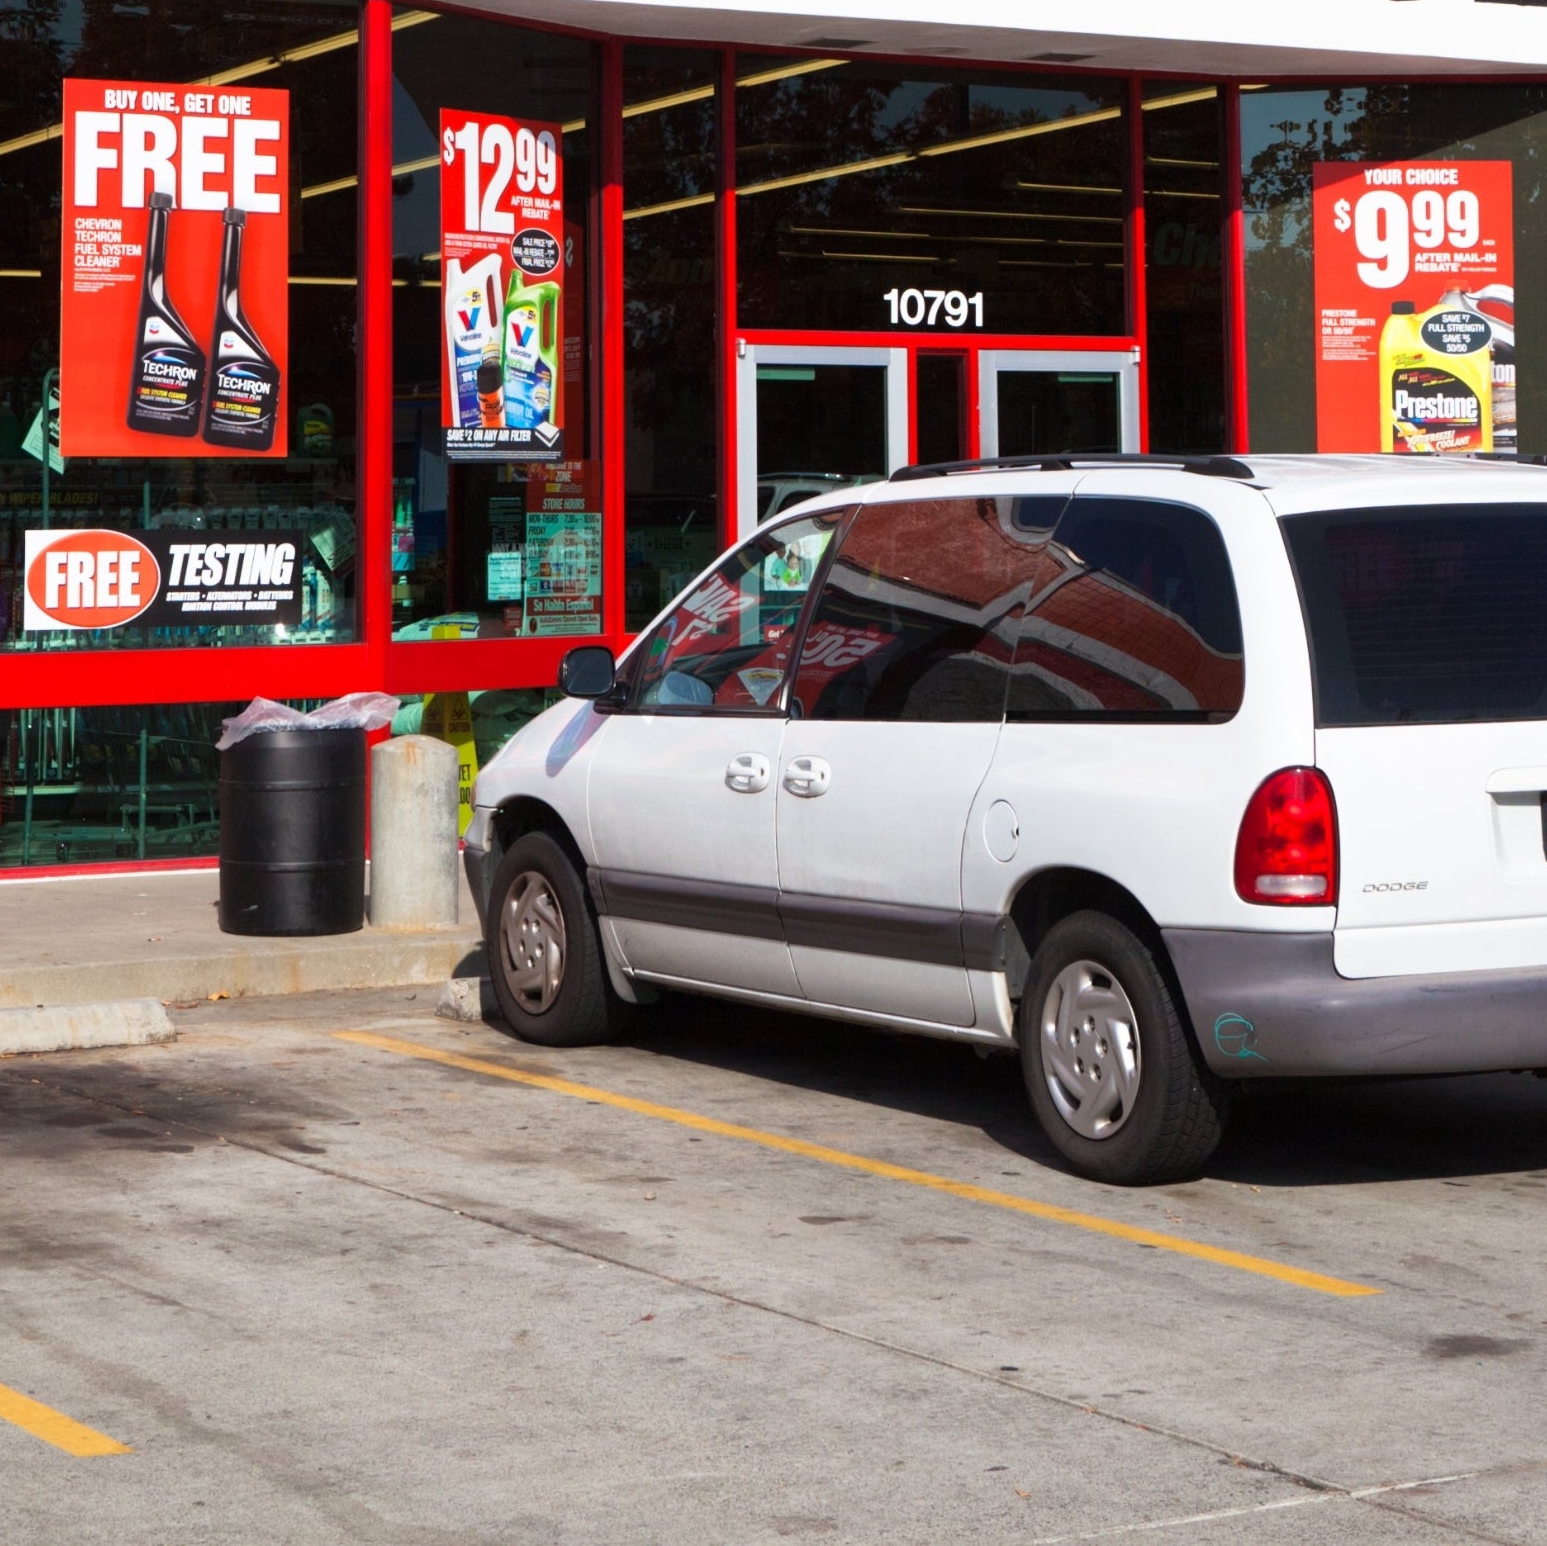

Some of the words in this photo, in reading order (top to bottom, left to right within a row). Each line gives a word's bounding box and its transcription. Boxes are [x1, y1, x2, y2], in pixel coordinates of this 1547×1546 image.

[105, 89, 137, 109] BUY
[142, 91, 180, 114] ONE,
[184, 93, 214, 114] GET
[218, 95, 251, 116] ONE
[74, 111, 280, 214] FREE
[1364, 169, 1402, 185] YOUR
[1406, 169, 1458, 185] CHOICE
[511, 196, 533, 207] AFTER
[535, 198, 560, 210] MAIL-IN
[75, 218, 122, 230] CHEVRON
[75, 230, 122, 243] TECHRON
[75, 243, 99, 255] FUEL
[102, 244, 141, 256] SYSTEM
[1415, 253, 1451, 262] AFTER
[1454, 253, 1496, 263] MAIL-IN
[883, 288, 983, 327] 10791
[1322, 319, 1338, 327] FULL
[1340, 319, 1375, 327] STRENGTH
[1442, 314, 1461, 323] SAVE
[1428, 324, 1446, 333] FULL
[1447, 324, 1484, 333] STRENGTH
[1442, 334, 1461, 343] SAVE
[1446, 343, 1467, 353] 50/50
[143, 360, 197, 380] TECHRON
[218, 374, 271, 395] TECHRON
[1395, 390, 1478, 419] Prestone
[447, 430, 465, 441] SAVE
[474, 430, 482, 441] ON
[484, 430, 498, 441] ANY
[498, 430, 510, 441] AIR
[511, 430, 532, 442] FILTER
[543, 498, 563, 510] STORE
[564, 498, 585, 510] HOURS
[45, 550, 140, 609] FREE
[168, 543, 296, 586] TESTING
[166, 591, 201, 601] STARTERS
[206, 591, 252, 601] ALTERNATORS
[213, 601, 243, 611] CONTROL
[534, 599, 543, 611] Se
[545, 598, 564, 611] Habla
[1362, 881, 1429, 893] DODGE
